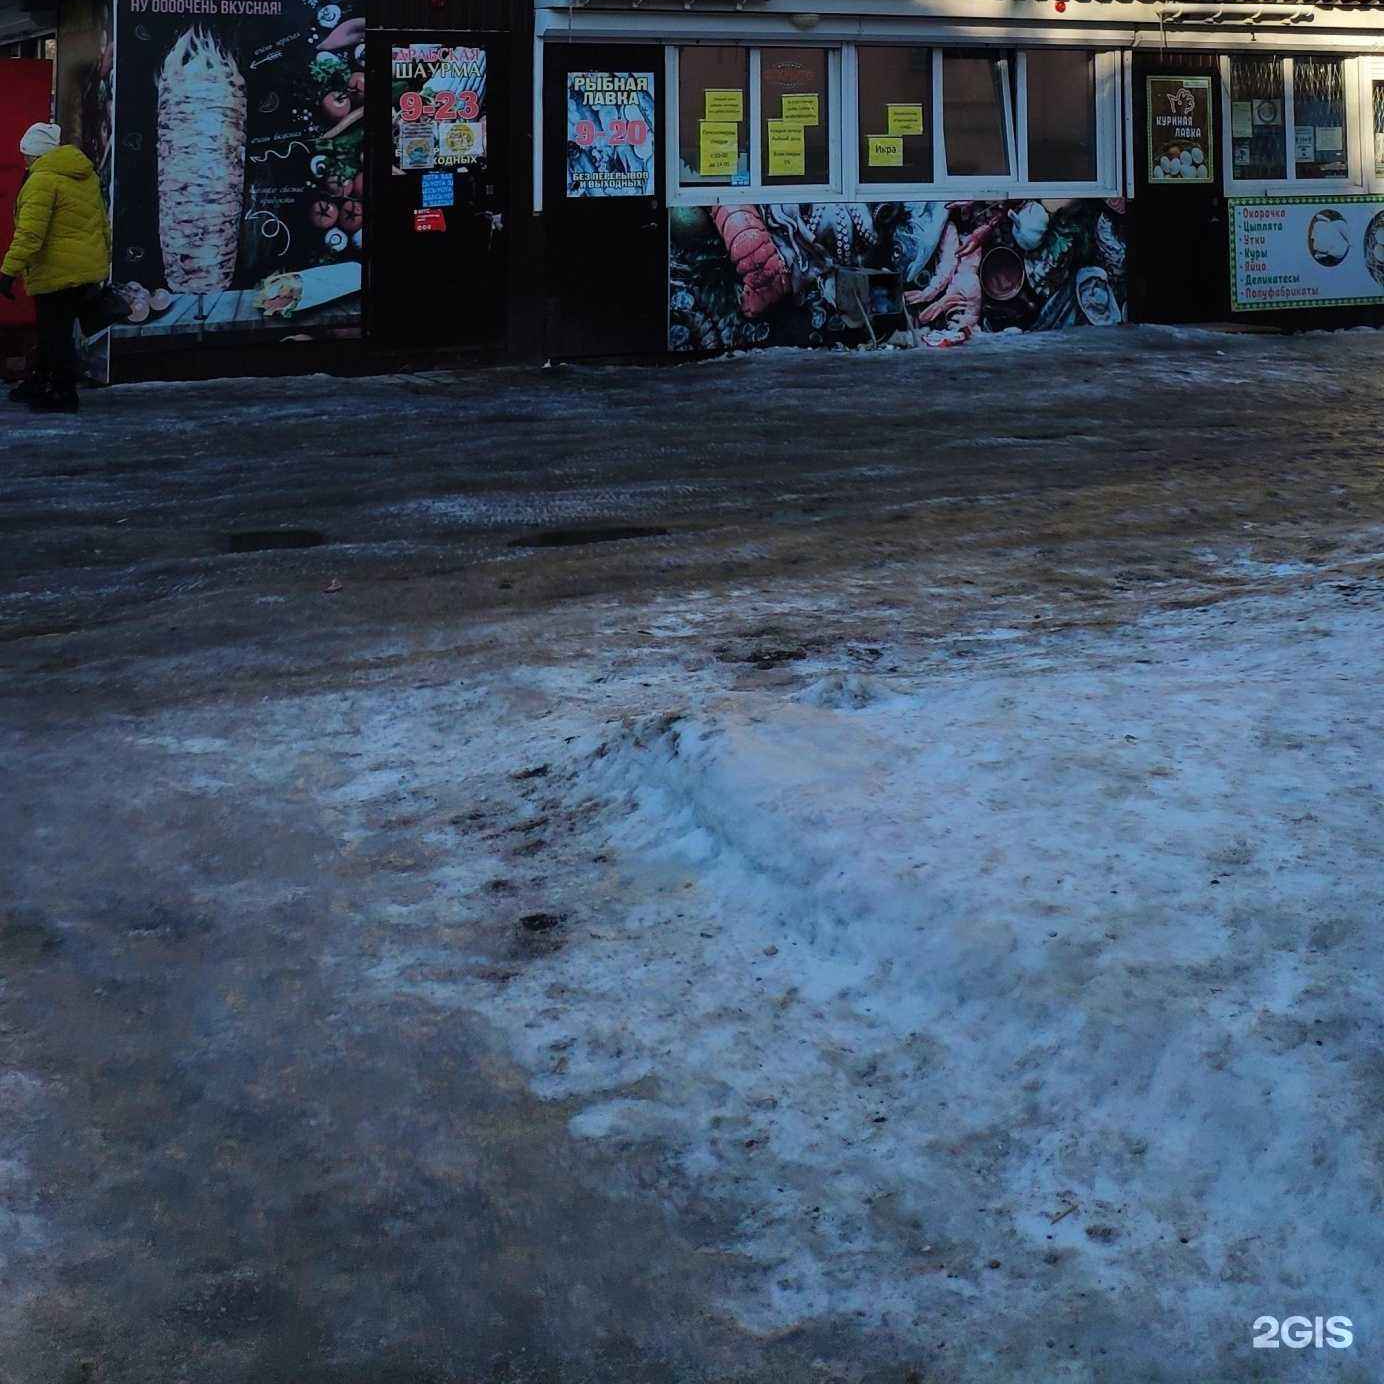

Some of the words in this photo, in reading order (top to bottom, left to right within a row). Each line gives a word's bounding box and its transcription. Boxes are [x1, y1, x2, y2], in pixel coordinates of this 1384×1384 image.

[221, 0, 281, 15] ВКУСНАЯ!
[396, 62, 480, 78] ШАУРМА
[574, 77, 648, 91] РЫБНАЯ
[583, 91, 639, 105] ЛАВКА
[400, 90, 480, 121] 9-23
[1156, 115, 1193, 126] КУРИНАЯ
[575, 119, 647, 146] 9-20
[1175, 127, 1201, 138] ЛАВКА
[875, 144, 897, 155] Икра
[573, 173, 590, 181] БЕЗ
[592, 171, 648, 181] ПЕРЕРЫВОВ
[1243, 207, 1286, 220] Окорочка
[1243, 221, 1283, 233] Цыплята
[1244, 234, 1265, 245] Утки
[1244, 247, 1268, 260] Куры
[1246, 274, 1300, 286] Деликатесы
